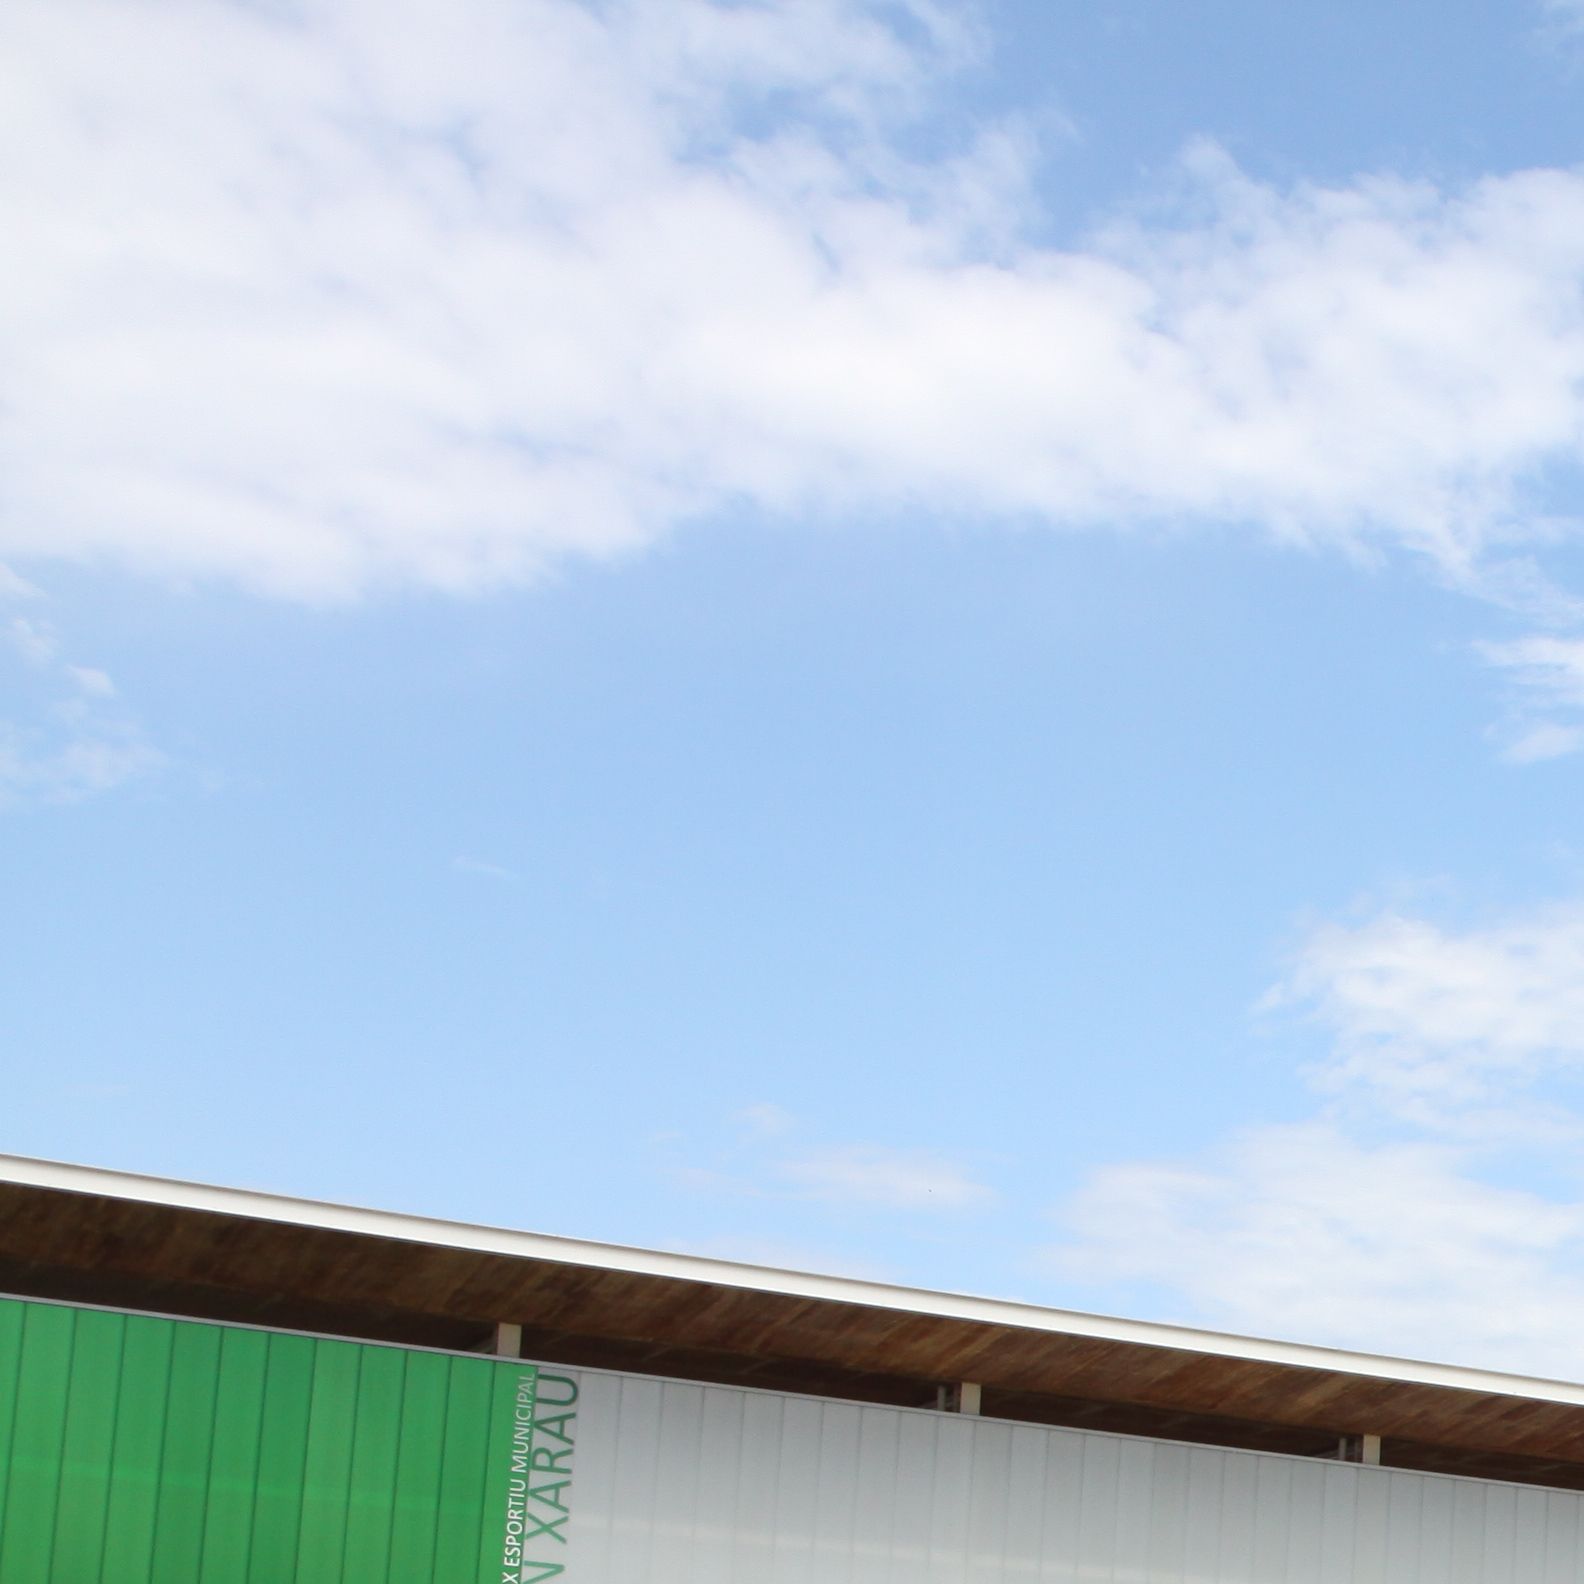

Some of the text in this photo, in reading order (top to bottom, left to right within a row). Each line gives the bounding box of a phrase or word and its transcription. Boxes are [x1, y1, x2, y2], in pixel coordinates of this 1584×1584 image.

[511, 1374, 536, 1473] MUNICIPAL
[525, 1374, 579, 1545] XARAU
[504, 1478, 527, 1567] ESPORTIU
